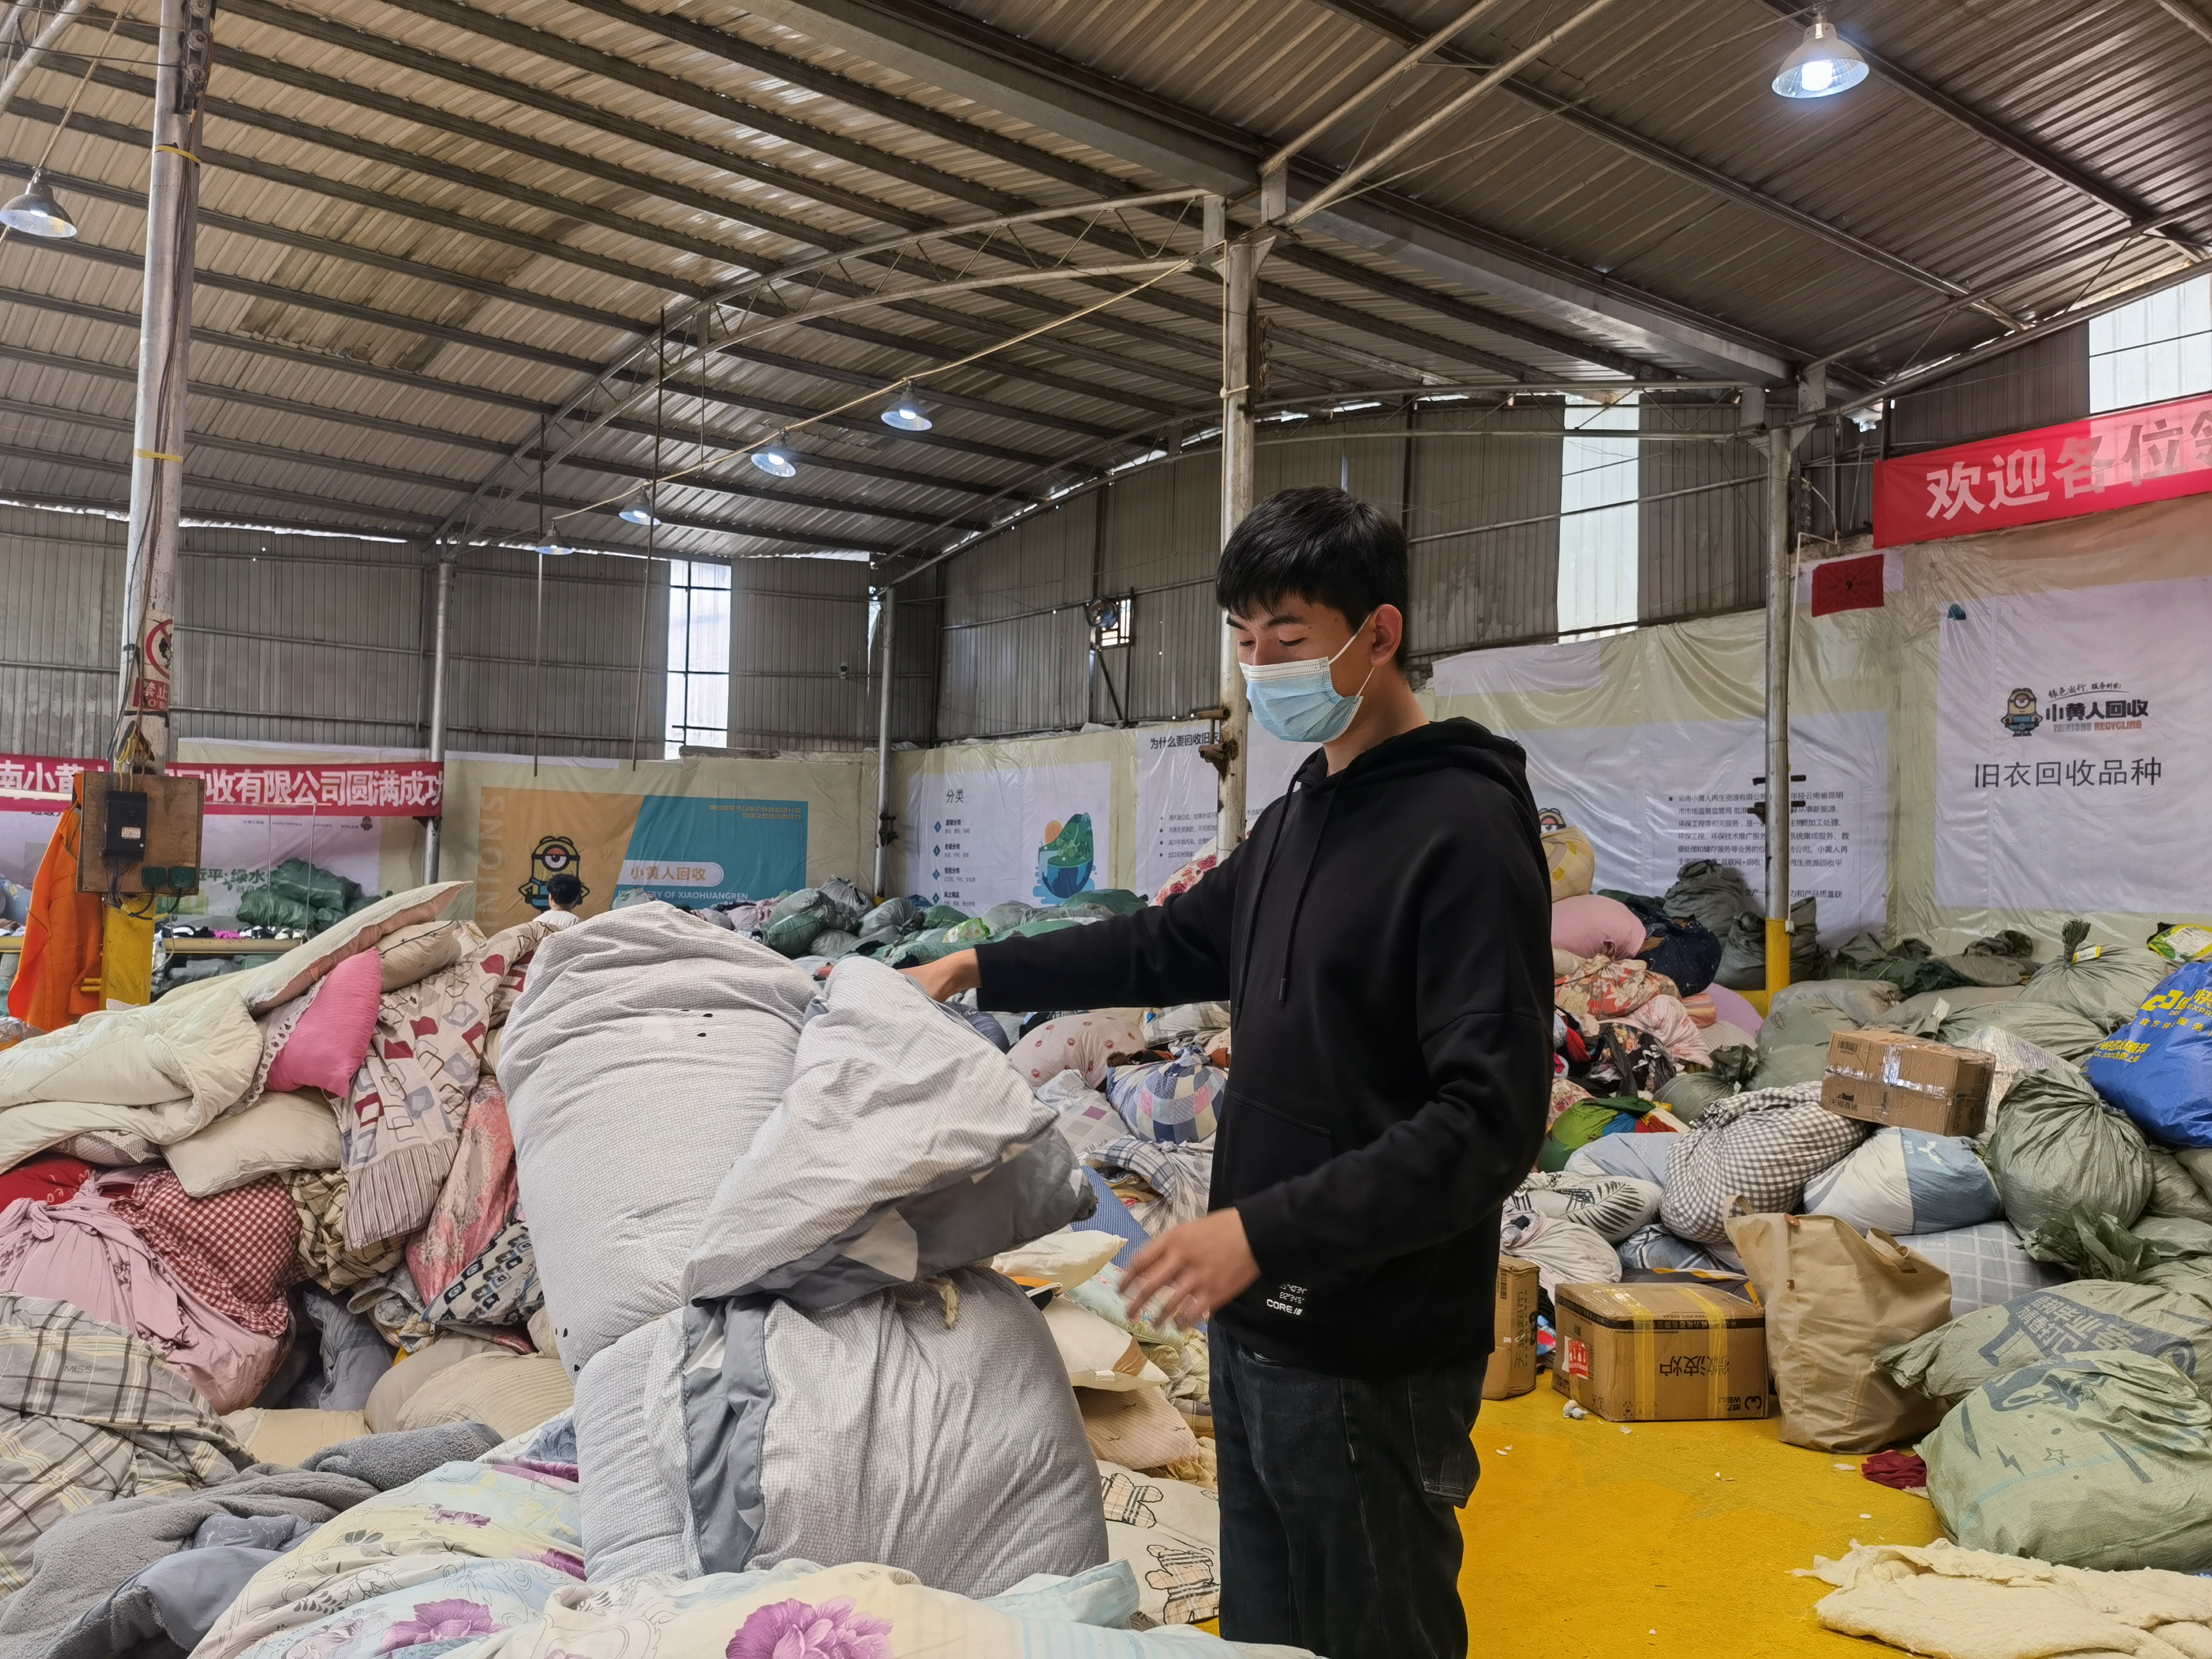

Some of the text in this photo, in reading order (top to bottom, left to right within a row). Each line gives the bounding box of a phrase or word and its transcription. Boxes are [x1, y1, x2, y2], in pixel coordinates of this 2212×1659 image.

[2046, 699, 2149, 722] 小黄人回收
[1974, 756, 2162, 788] 旧衣回收品种
[164, 768, 443, 807] 收有限公司圆满成功
[946, 788, 964, 804] 分类
[630, 865, 707, 881] 小黄人回收
[679, 892, 748, 900] XIAOHUANGREN
[1266, 1299, 1293, 1314] CORE
[63, 1365, 93, 1373] MISS
[1660, 1355, 1730, 1377] 微波炉
